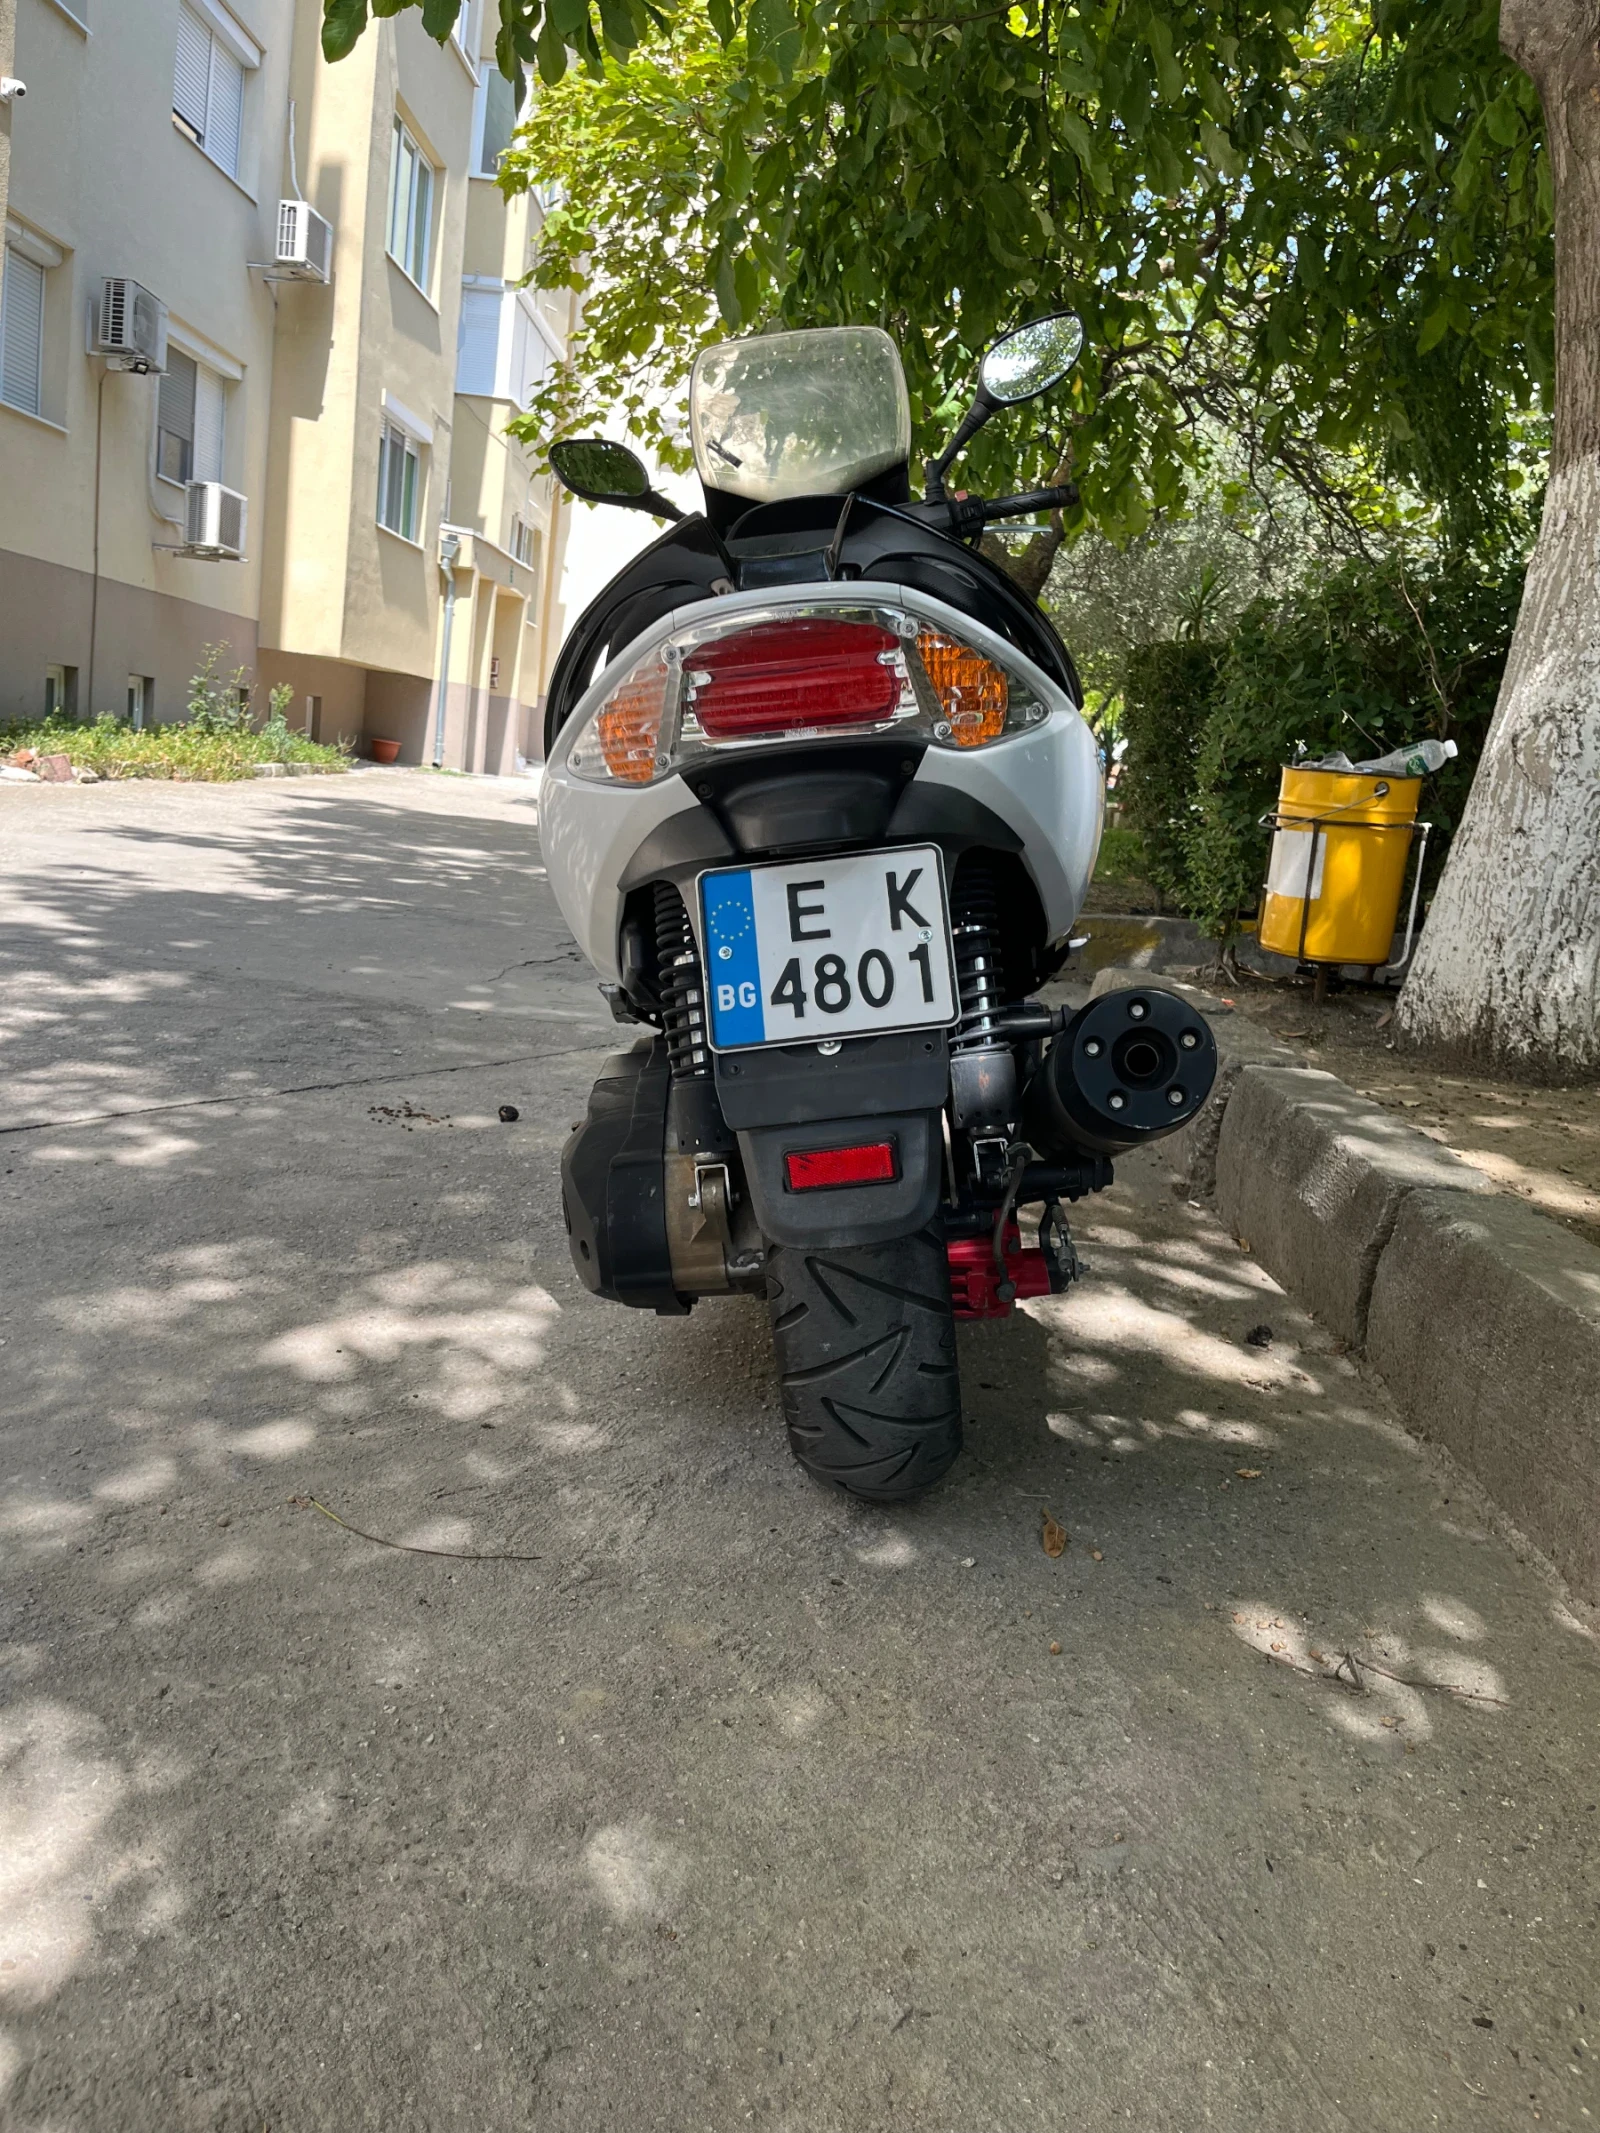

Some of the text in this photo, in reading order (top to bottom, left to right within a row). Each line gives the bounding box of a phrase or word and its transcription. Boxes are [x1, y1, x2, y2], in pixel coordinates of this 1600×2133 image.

[786, 867, 932, 942] E K
[717, 981, 757, 1012] BG
[770, 943, 935, 1019] 4801
